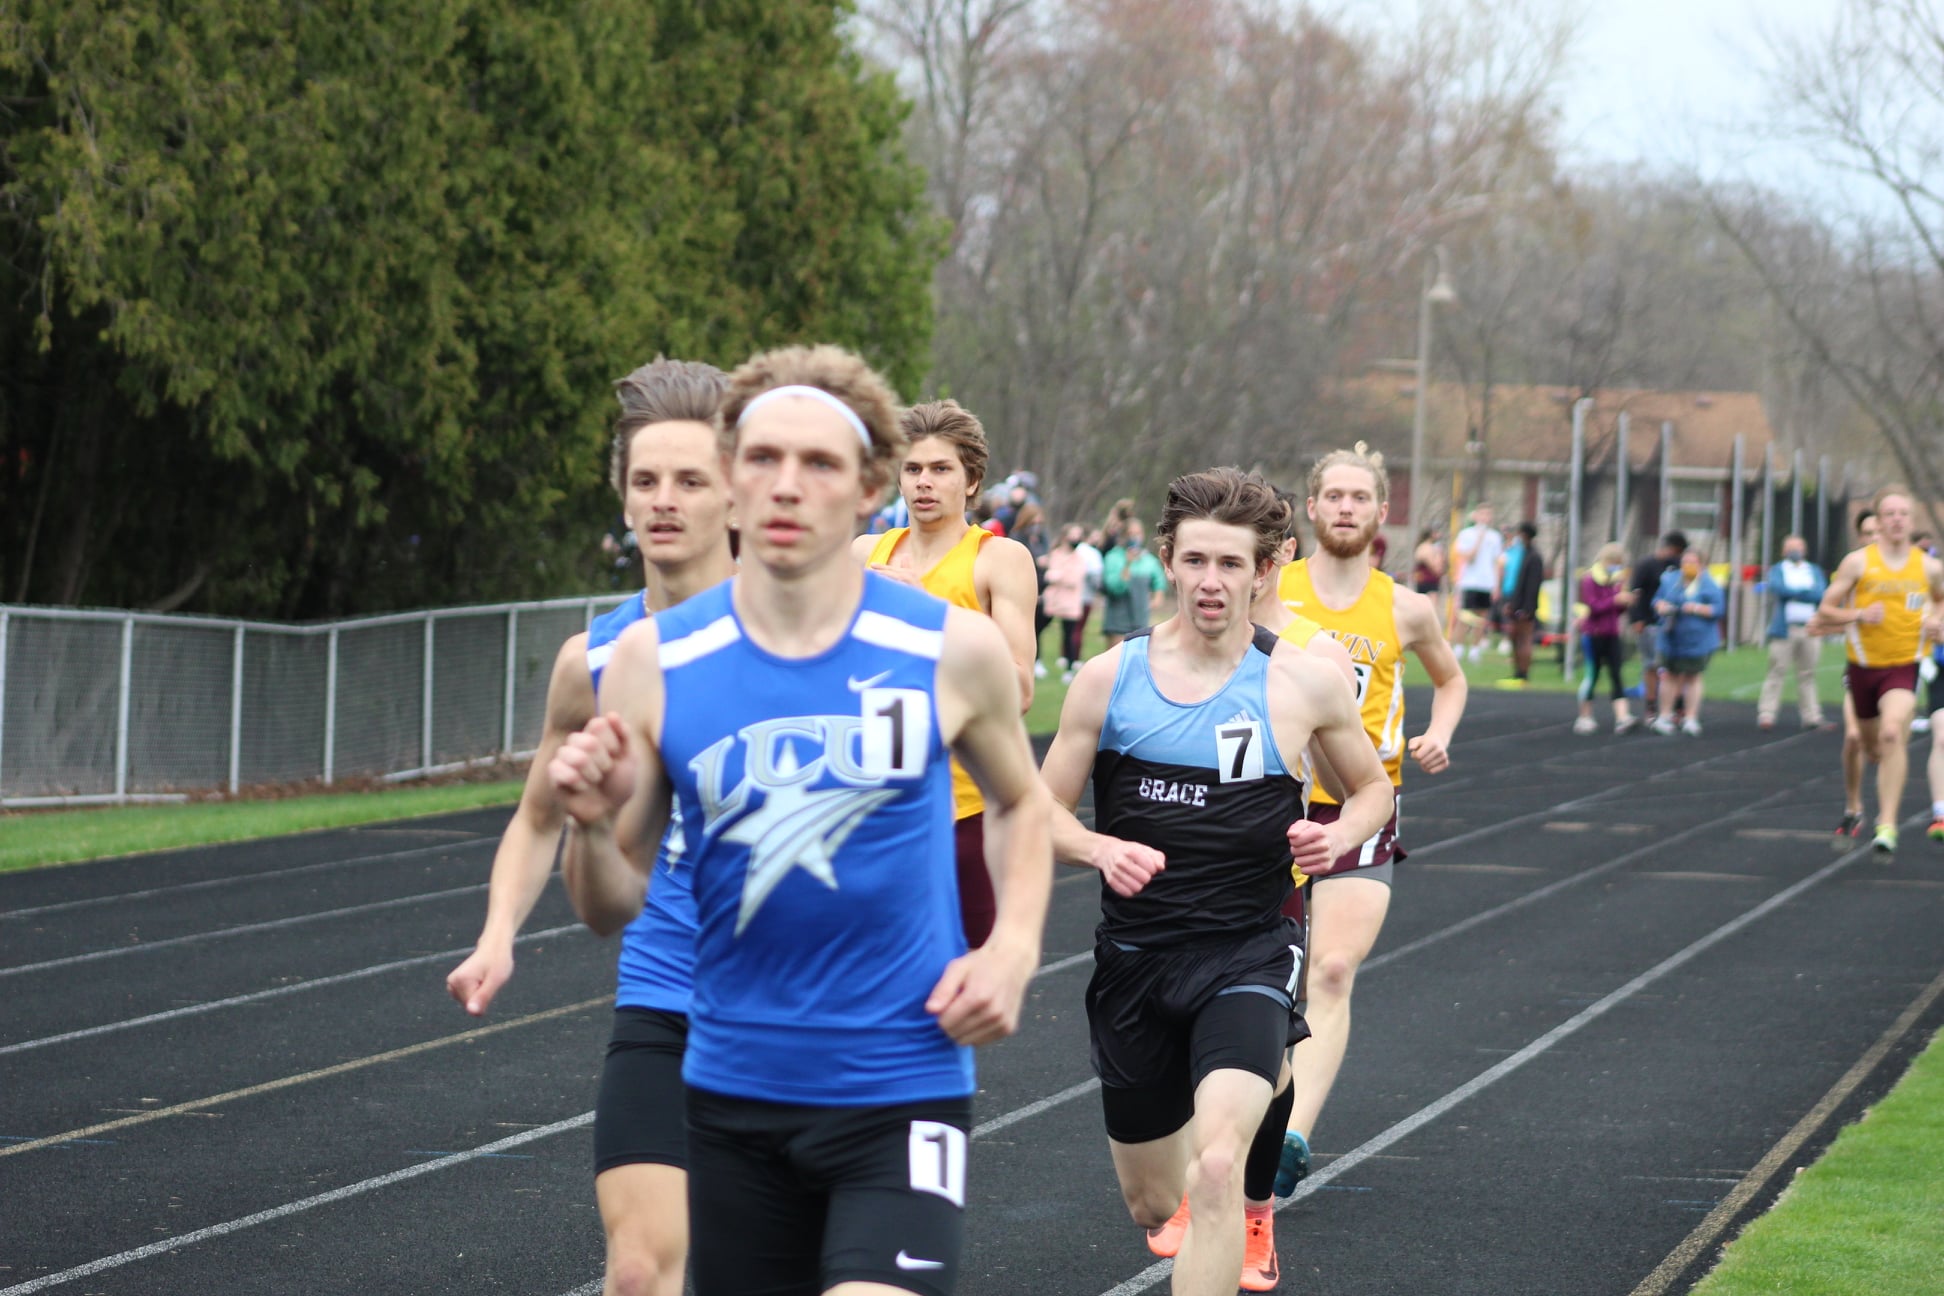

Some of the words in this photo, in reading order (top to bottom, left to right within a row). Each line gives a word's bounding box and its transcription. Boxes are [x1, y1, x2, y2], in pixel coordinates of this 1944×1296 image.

[877, 697, 904, 770] 1
[1221, 728, 1253, 779] 7
[1139, 777, 1209, 807] GRACE
[923, 1129, 948, 1189] 1
